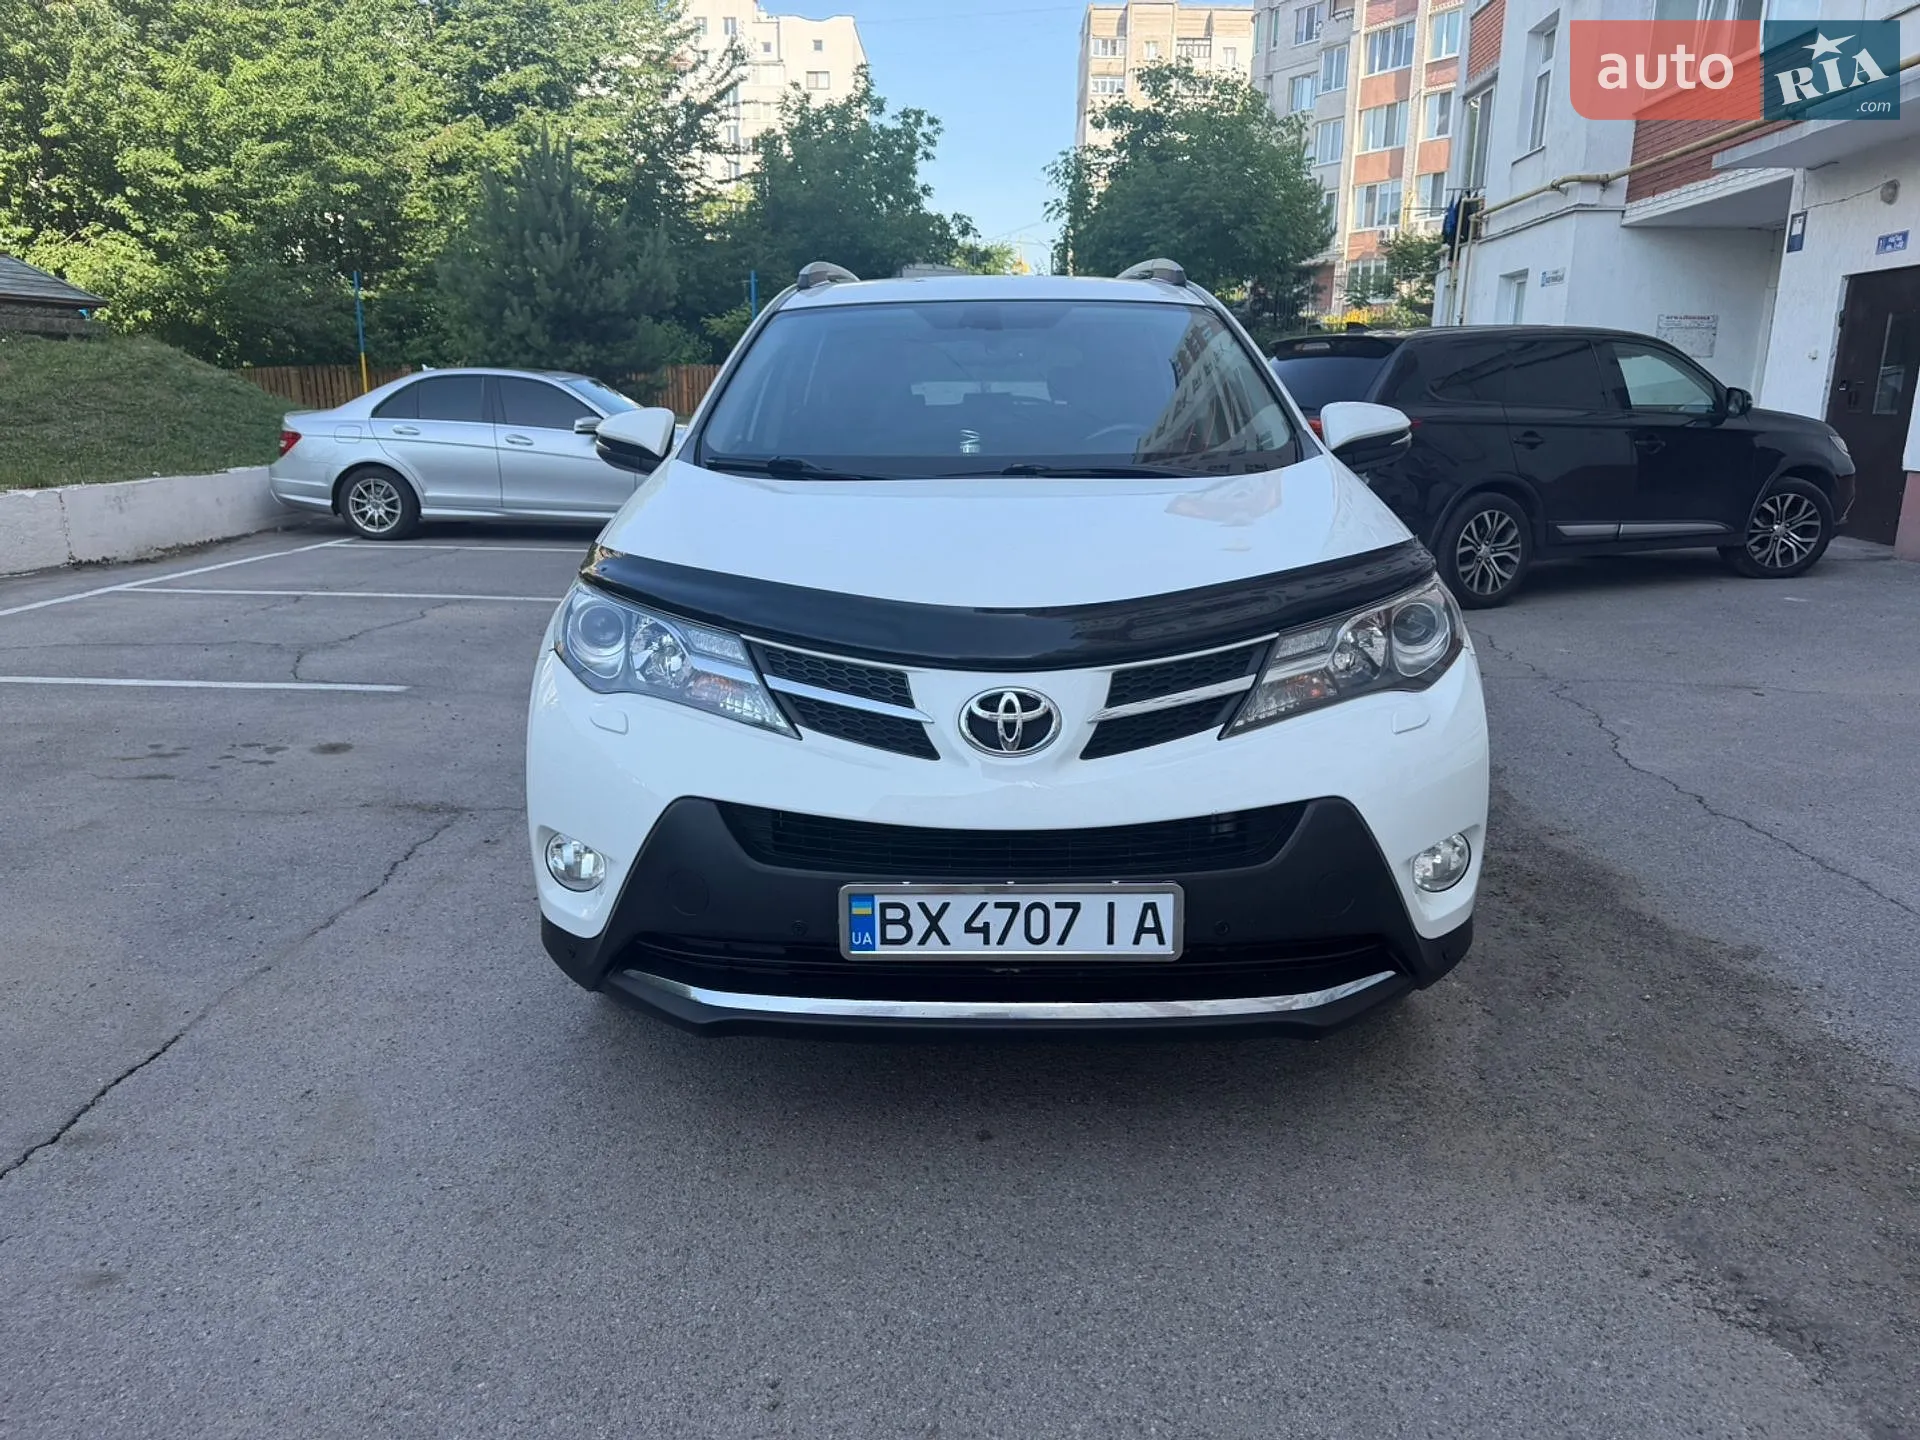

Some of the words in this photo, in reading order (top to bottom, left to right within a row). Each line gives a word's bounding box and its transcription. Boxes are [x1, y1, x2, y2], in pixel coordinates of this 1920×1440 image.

[879, 901, 951, 946] BX
[964, 901, 1082, 946] 4707
[851, 932, 873, 945] UA
